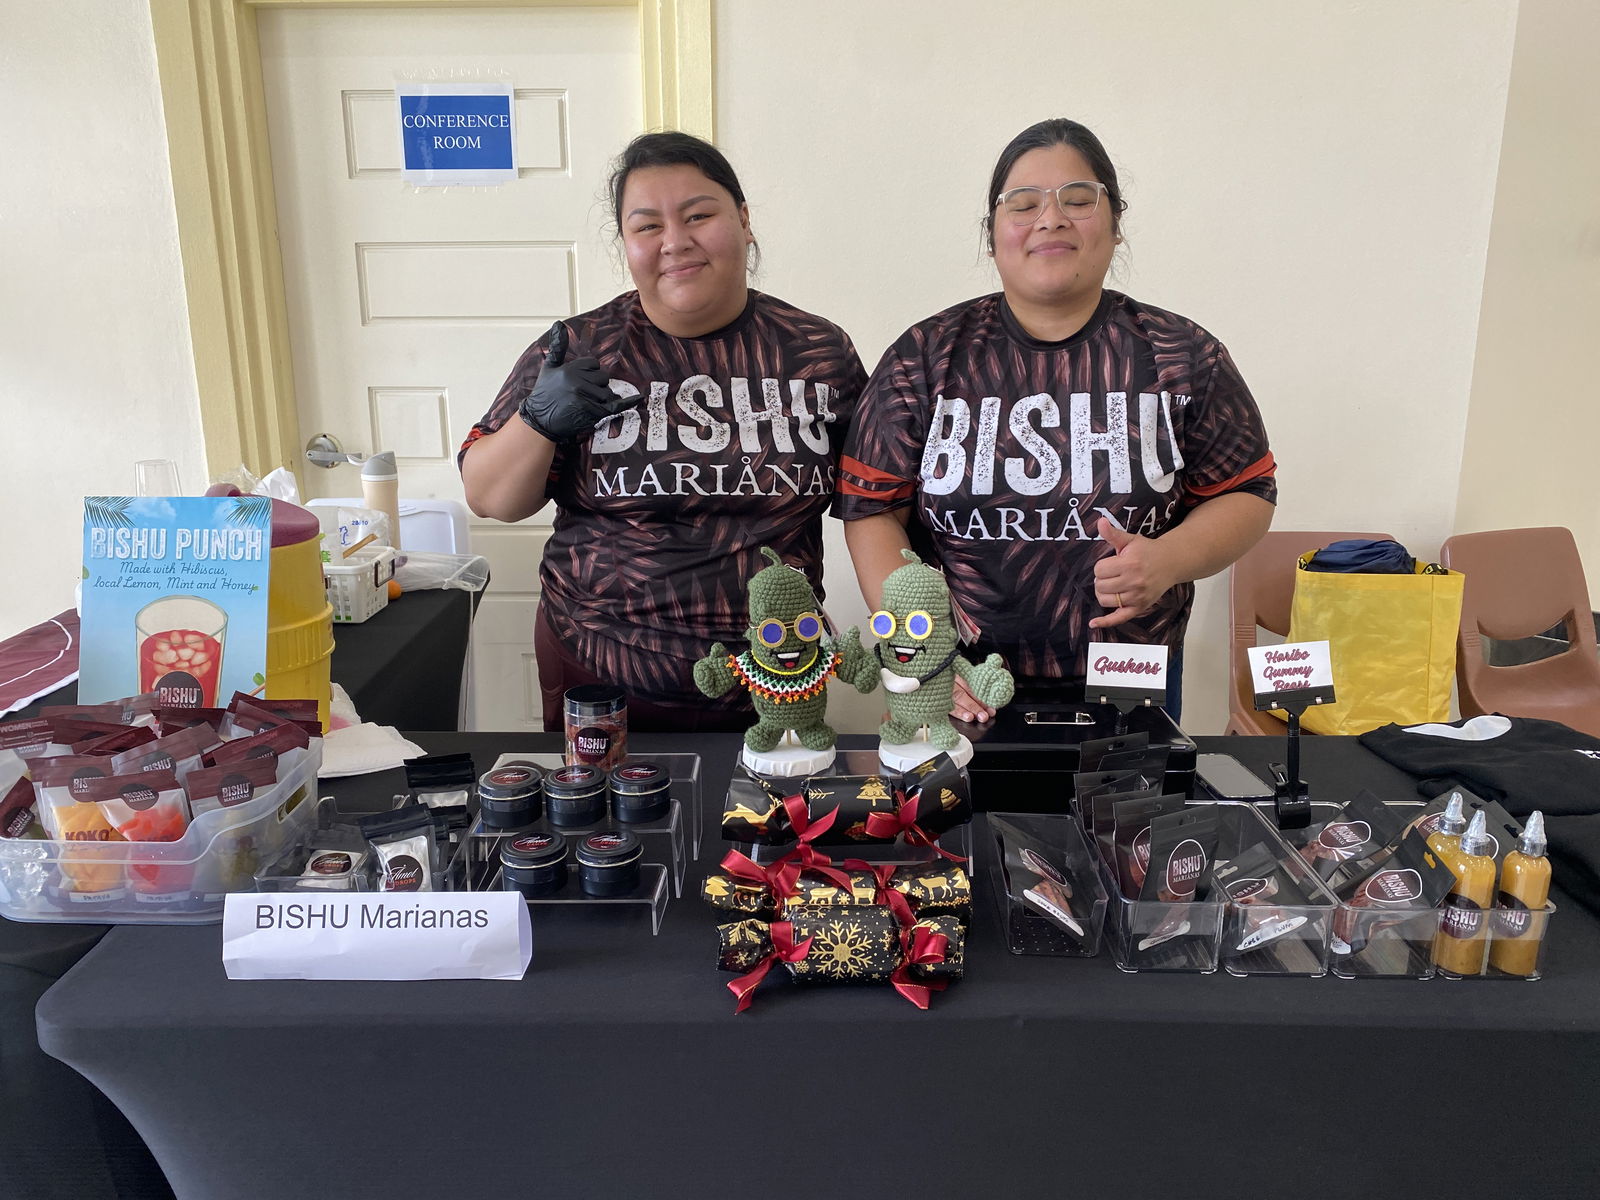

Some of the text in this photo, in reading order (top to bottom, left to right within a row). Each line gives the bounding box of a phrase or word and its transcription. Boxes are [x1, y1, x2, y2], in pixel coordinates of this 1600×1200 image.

[403, 114, 509, 128] CONFERENCE
[433, 136, 482, 149] ROOM
[920, 391, 1184, 496] BISHU
[91, 527, 262, 561] BISHU PUNCH
[120, 562, 228, 576] Made with Hibiscus,
[94, 576, 255, 595] local Lemon, Mint and Honey
[1264, 648, 1310, 664] Haribo
[1093, 656, 1161, 676] Gushers
[1263, 664, 1314, 679] Gummy
[160, 687, 198, 703] BISHU
[578, 736, 607, 750] BISHU
[222, 783, 250, 798] BISHU
[1172, 855, 1202, 876] BISHU
[1382, 874, 1414, 897] BISHU
[256, 904, 489, 929] BISHU Marianas
